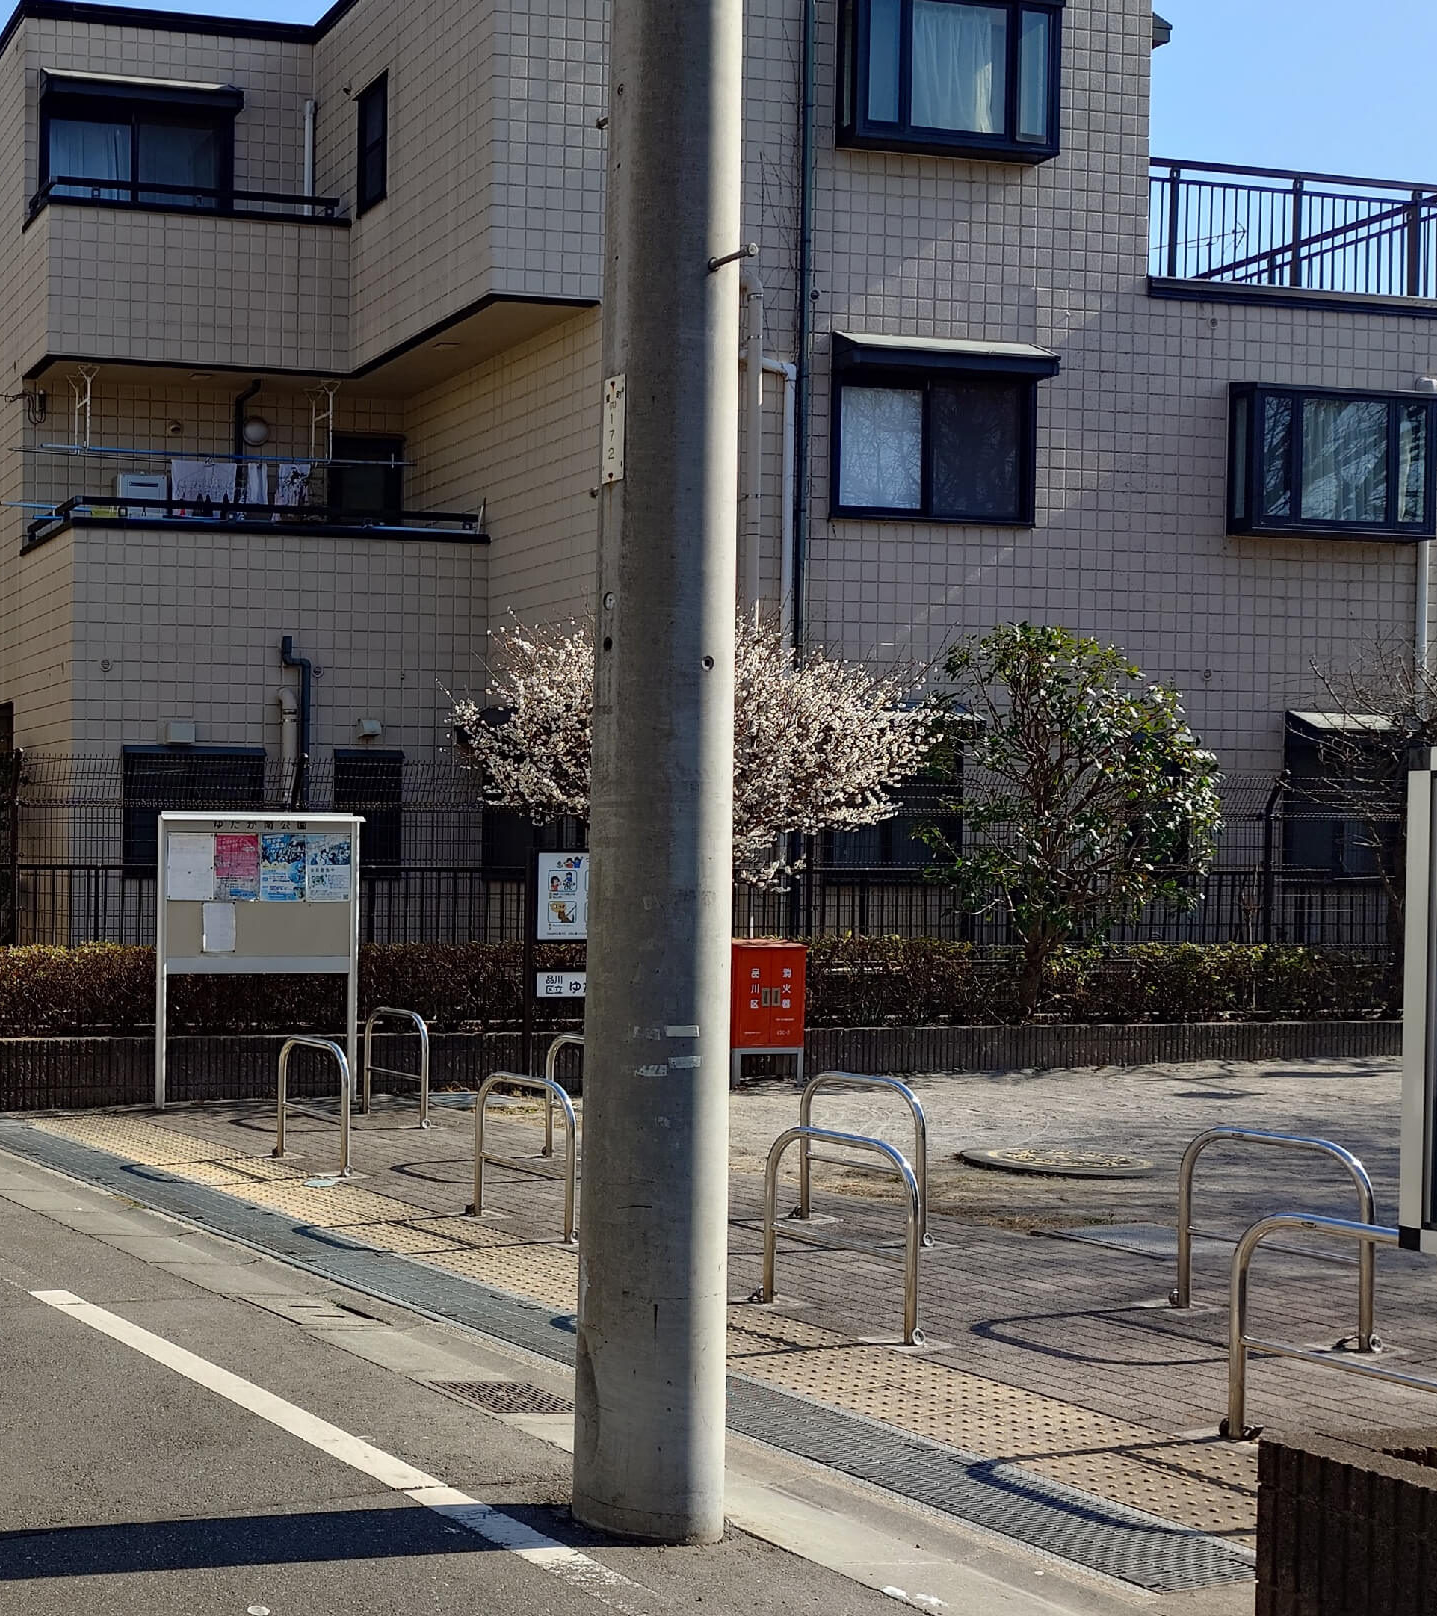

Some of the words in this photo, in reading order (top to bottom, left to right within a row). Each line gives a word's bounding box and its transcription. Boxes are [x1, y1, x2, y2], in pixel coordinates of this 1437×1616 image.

[545, 975, 563, 984] 品川
[545, 985, 563, 994] 区立
[750, 968, 760, 1009] 品川区
